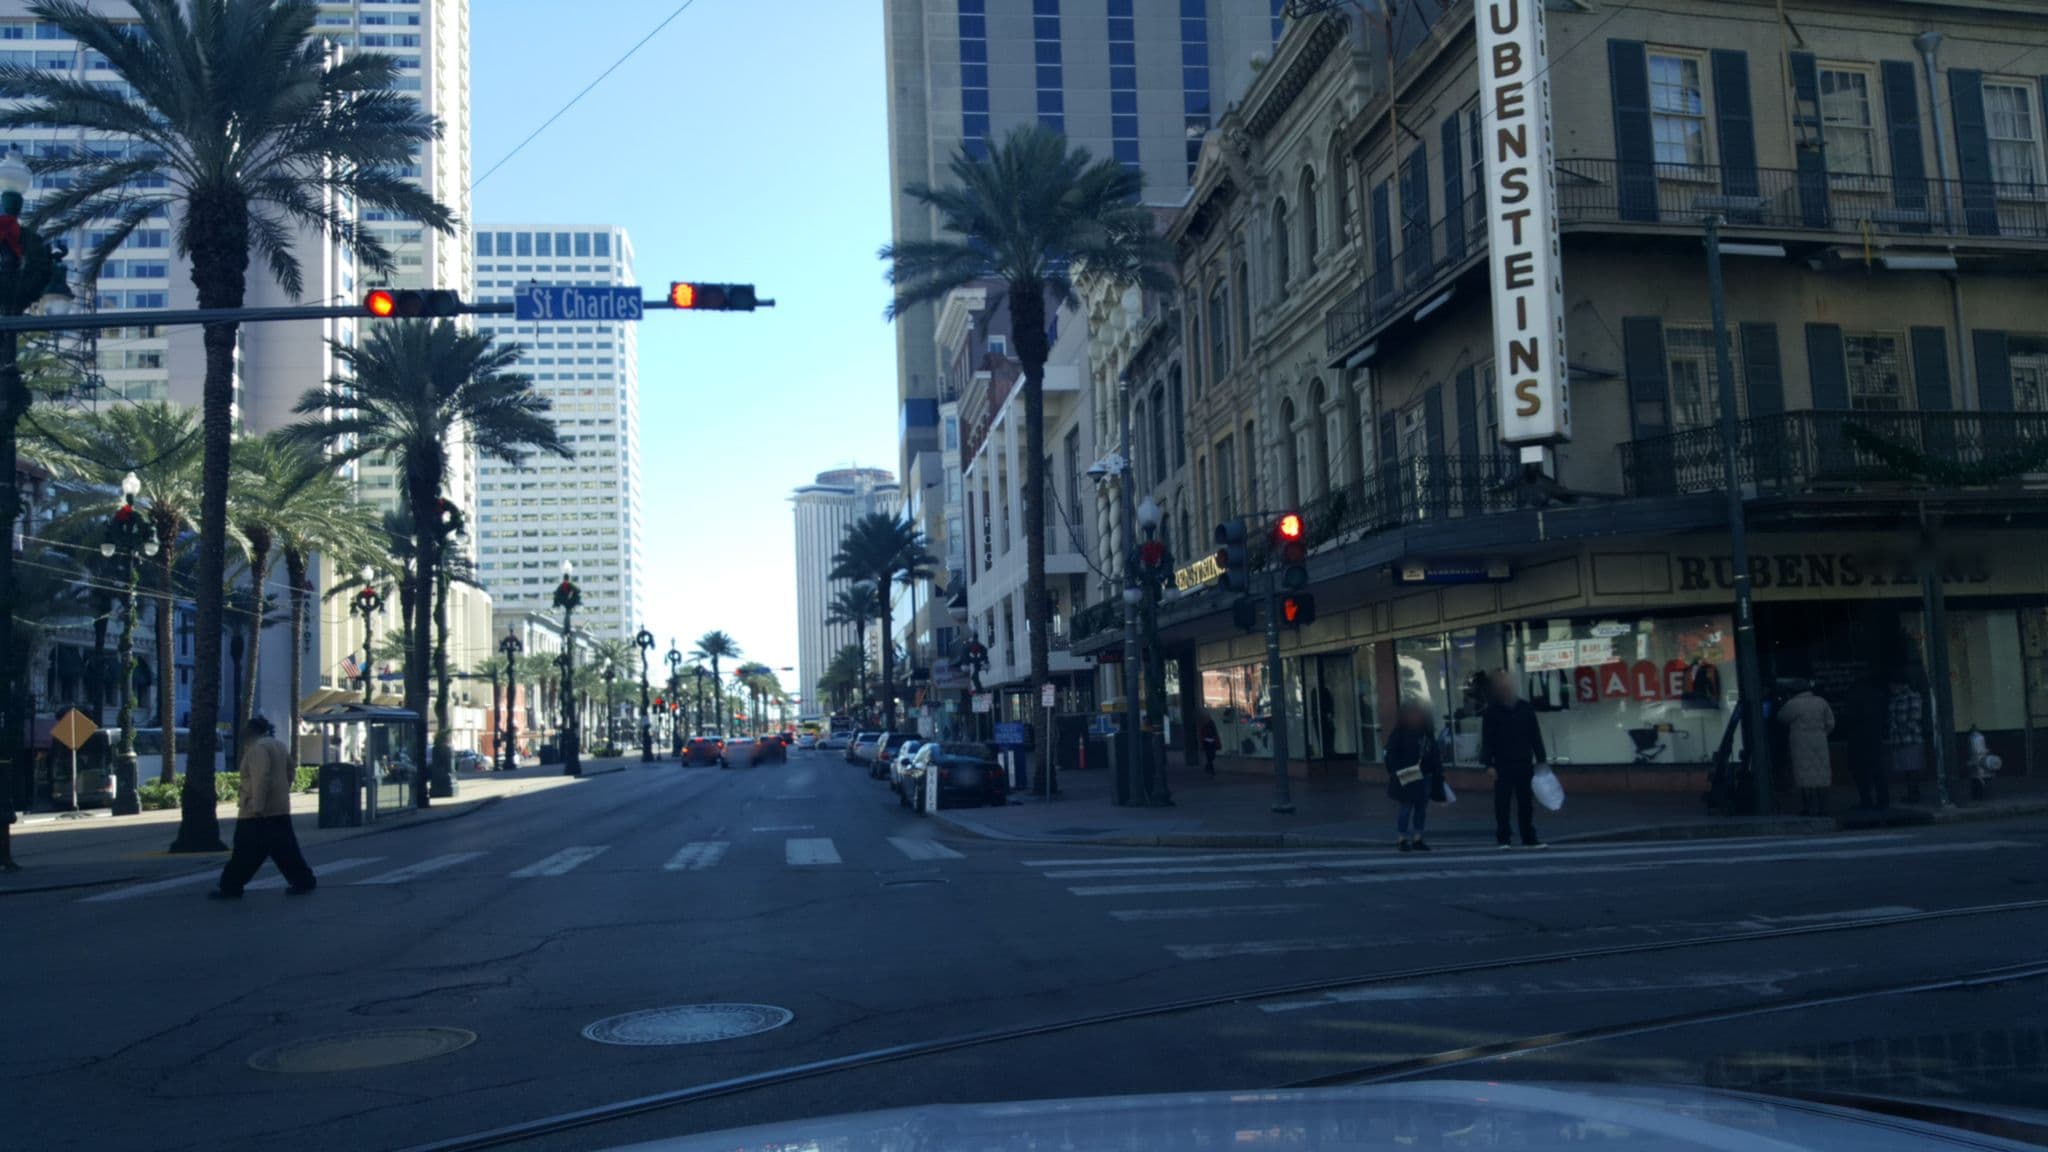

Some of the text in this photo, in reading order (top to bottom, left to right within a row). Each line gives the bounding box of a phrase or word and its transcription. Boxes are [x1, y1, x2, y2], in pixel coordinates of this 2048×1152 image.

[532, 287, 639, 319] St Charles
[1579, 670, 1684, 698] SALE
